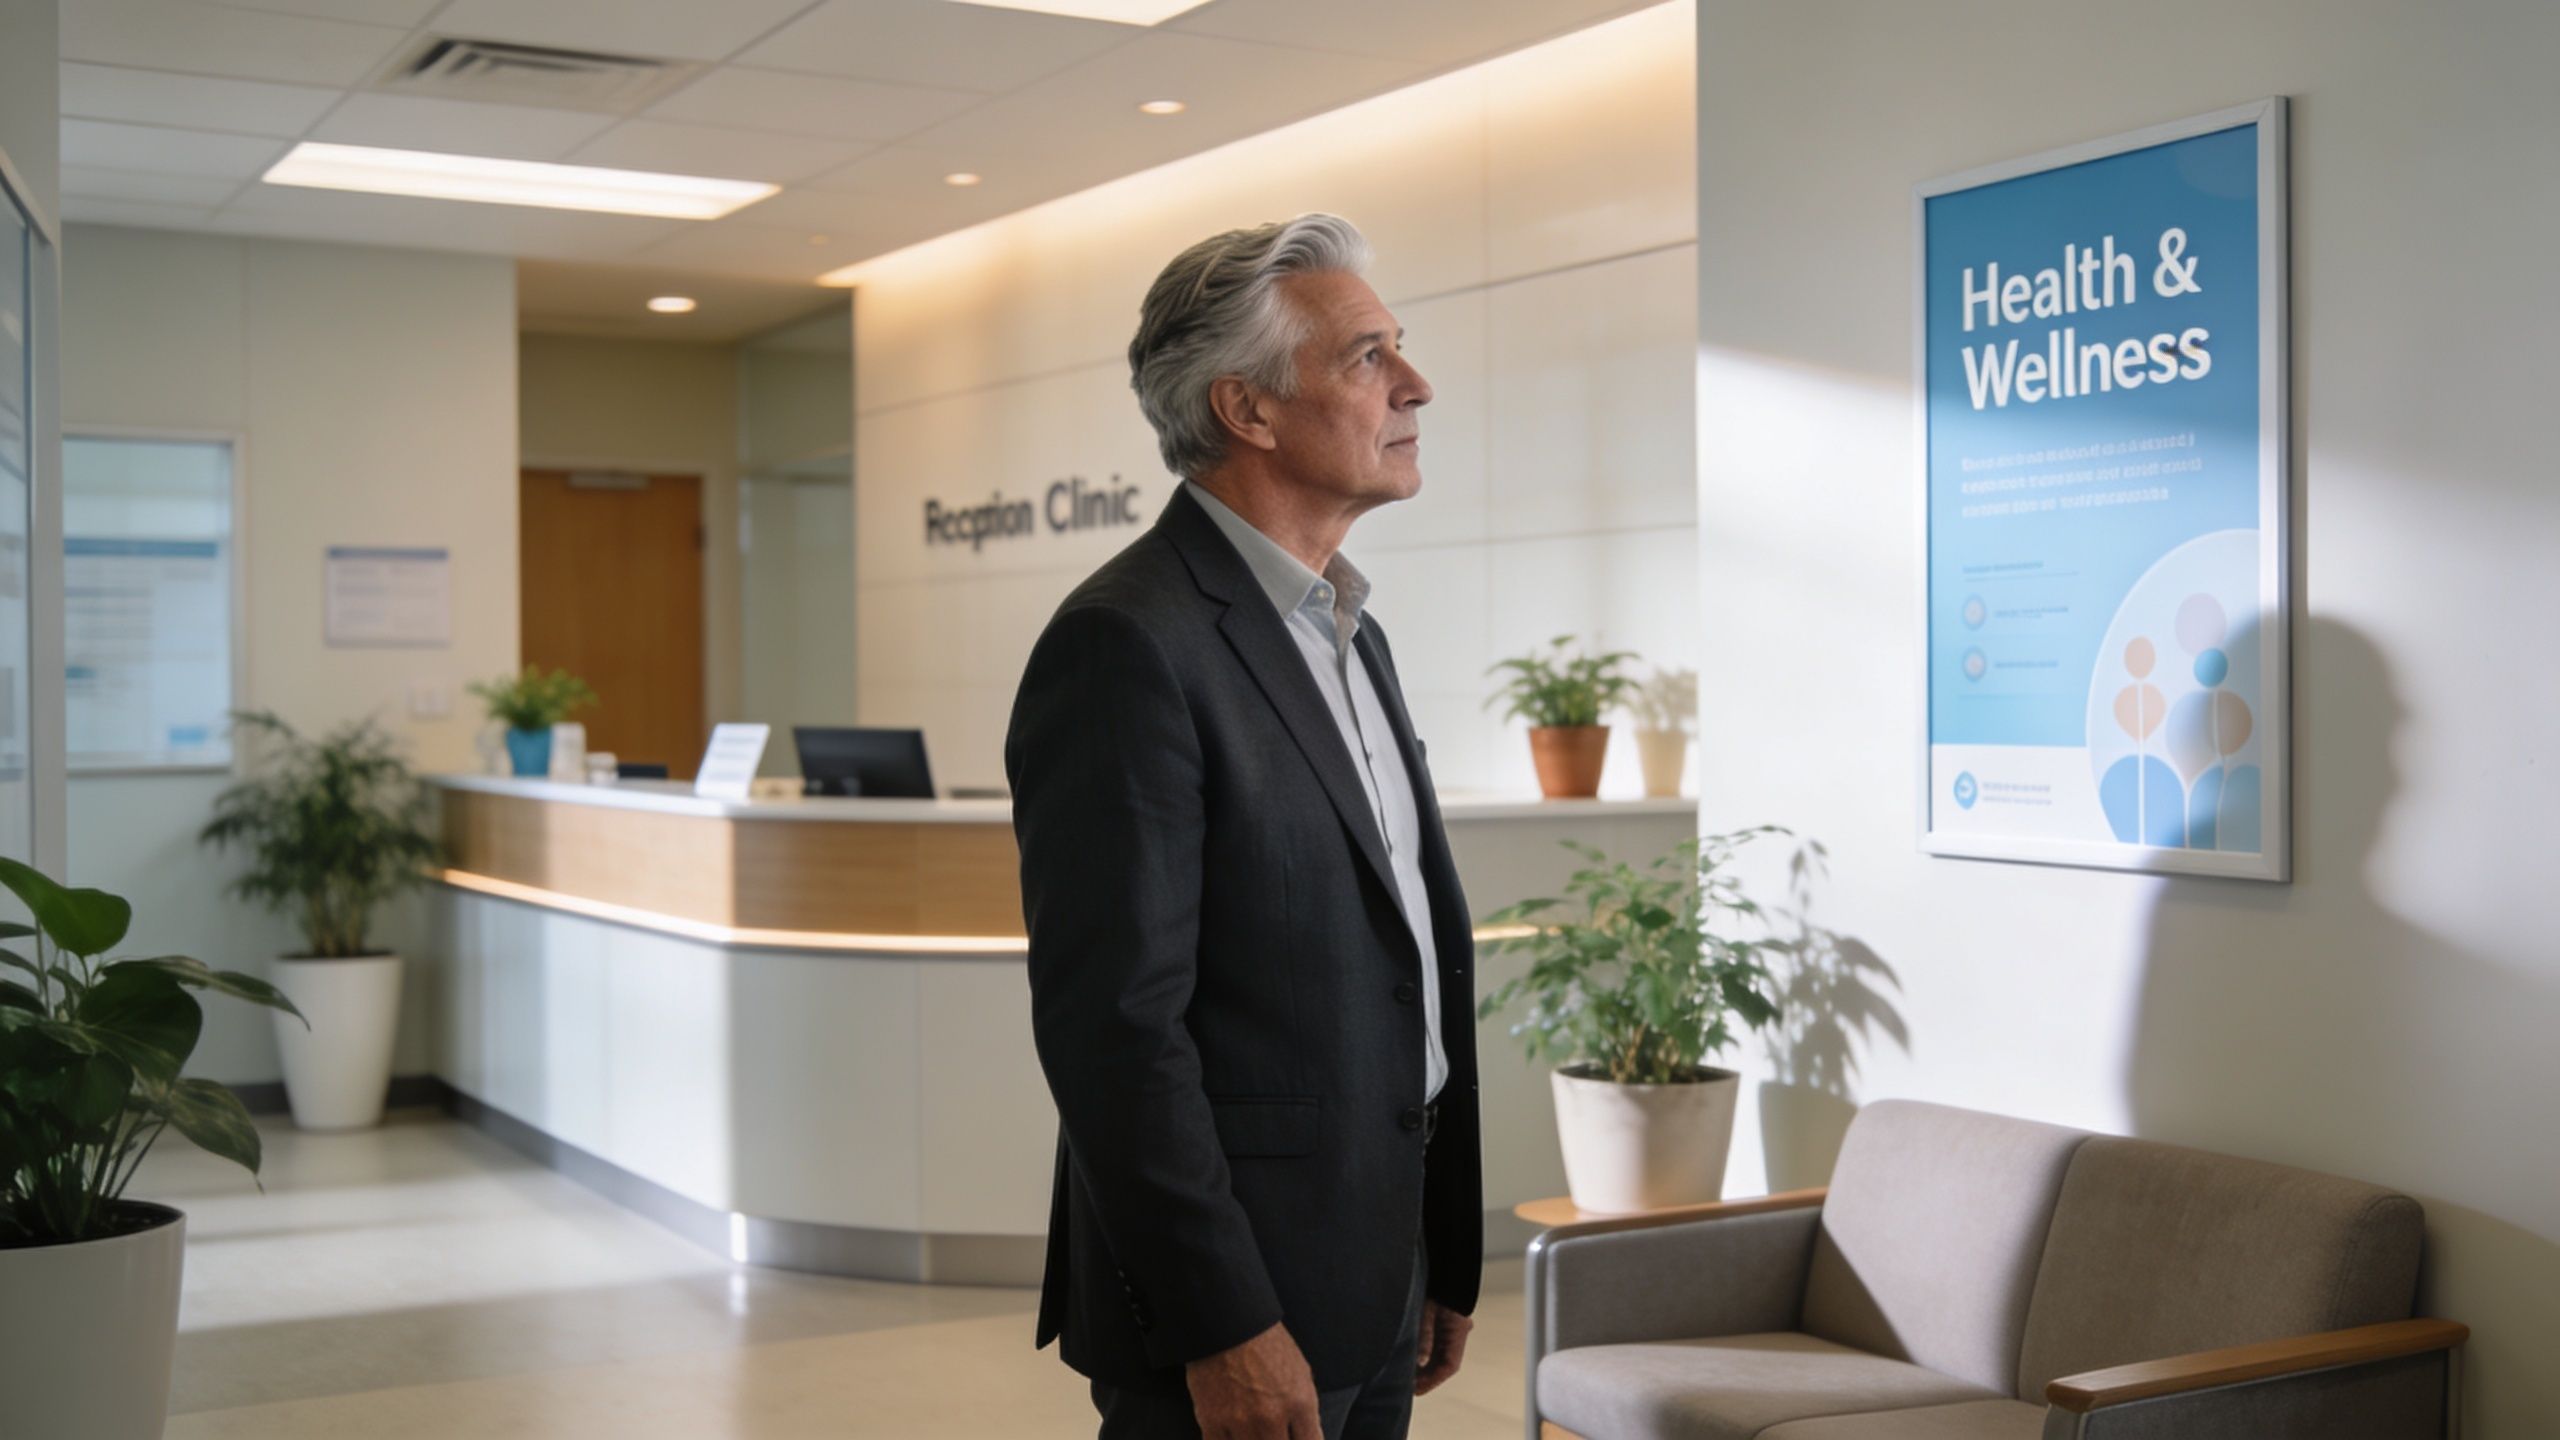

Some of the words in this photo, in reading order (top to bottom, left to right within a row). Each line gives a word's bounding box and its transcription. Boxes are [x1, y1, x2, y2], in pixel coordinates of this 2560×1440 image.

[1962, 234, 2136, 332] Health
[2153, 227, 2202, 298] &
[1961, 327, 2212, 411] Wellness
[1045, 474, 1141, 533] Clinic
